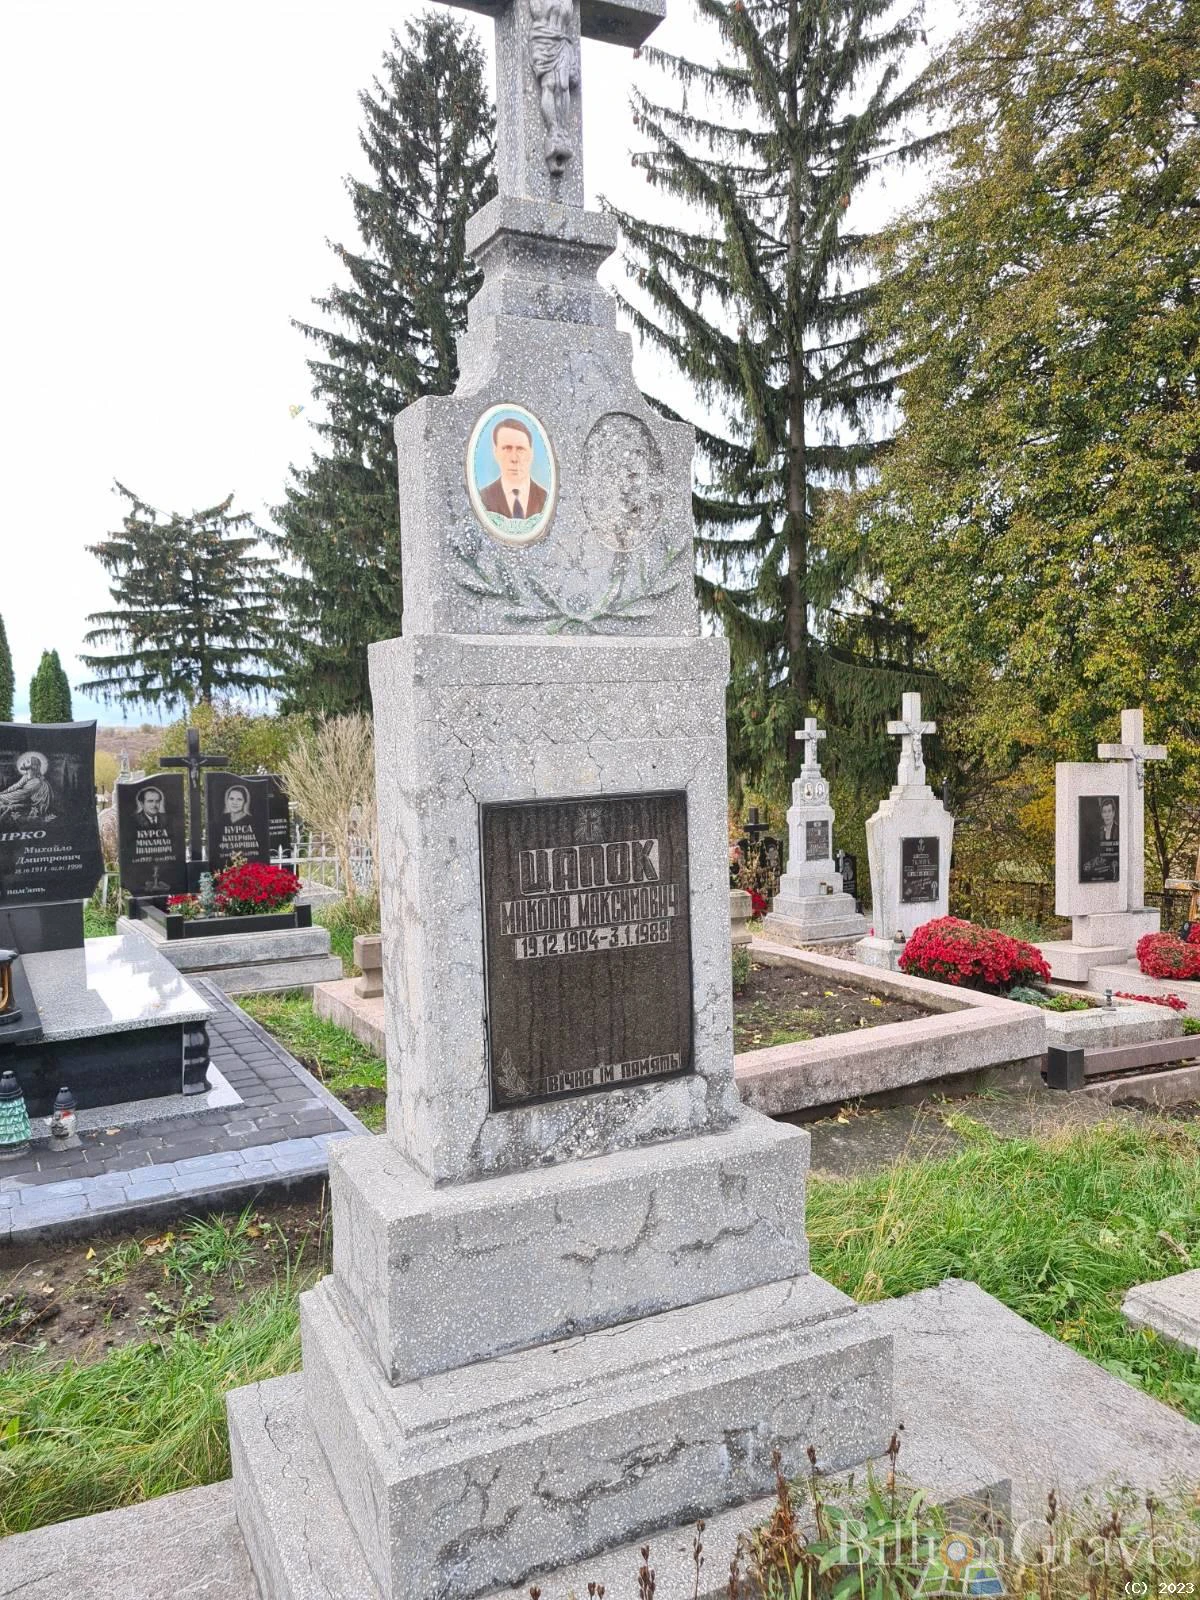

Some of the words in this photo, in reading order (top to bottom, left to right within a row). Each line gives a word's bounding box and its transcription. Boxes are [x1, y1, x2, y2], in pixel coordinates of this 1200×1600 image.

[137, 829, 168, 838] КУРСА
[224, 824, 253, 834] КУРСА
[24, 844, 72, 854] Михайло
[16, 854, 81, 865] Дмитрович
[519, 839, 660, 896] ЦАПОК
[501, 896, 571, 934] МИКОЛА
[577, 884, 679, 925] МАКСИМОВИЧ
